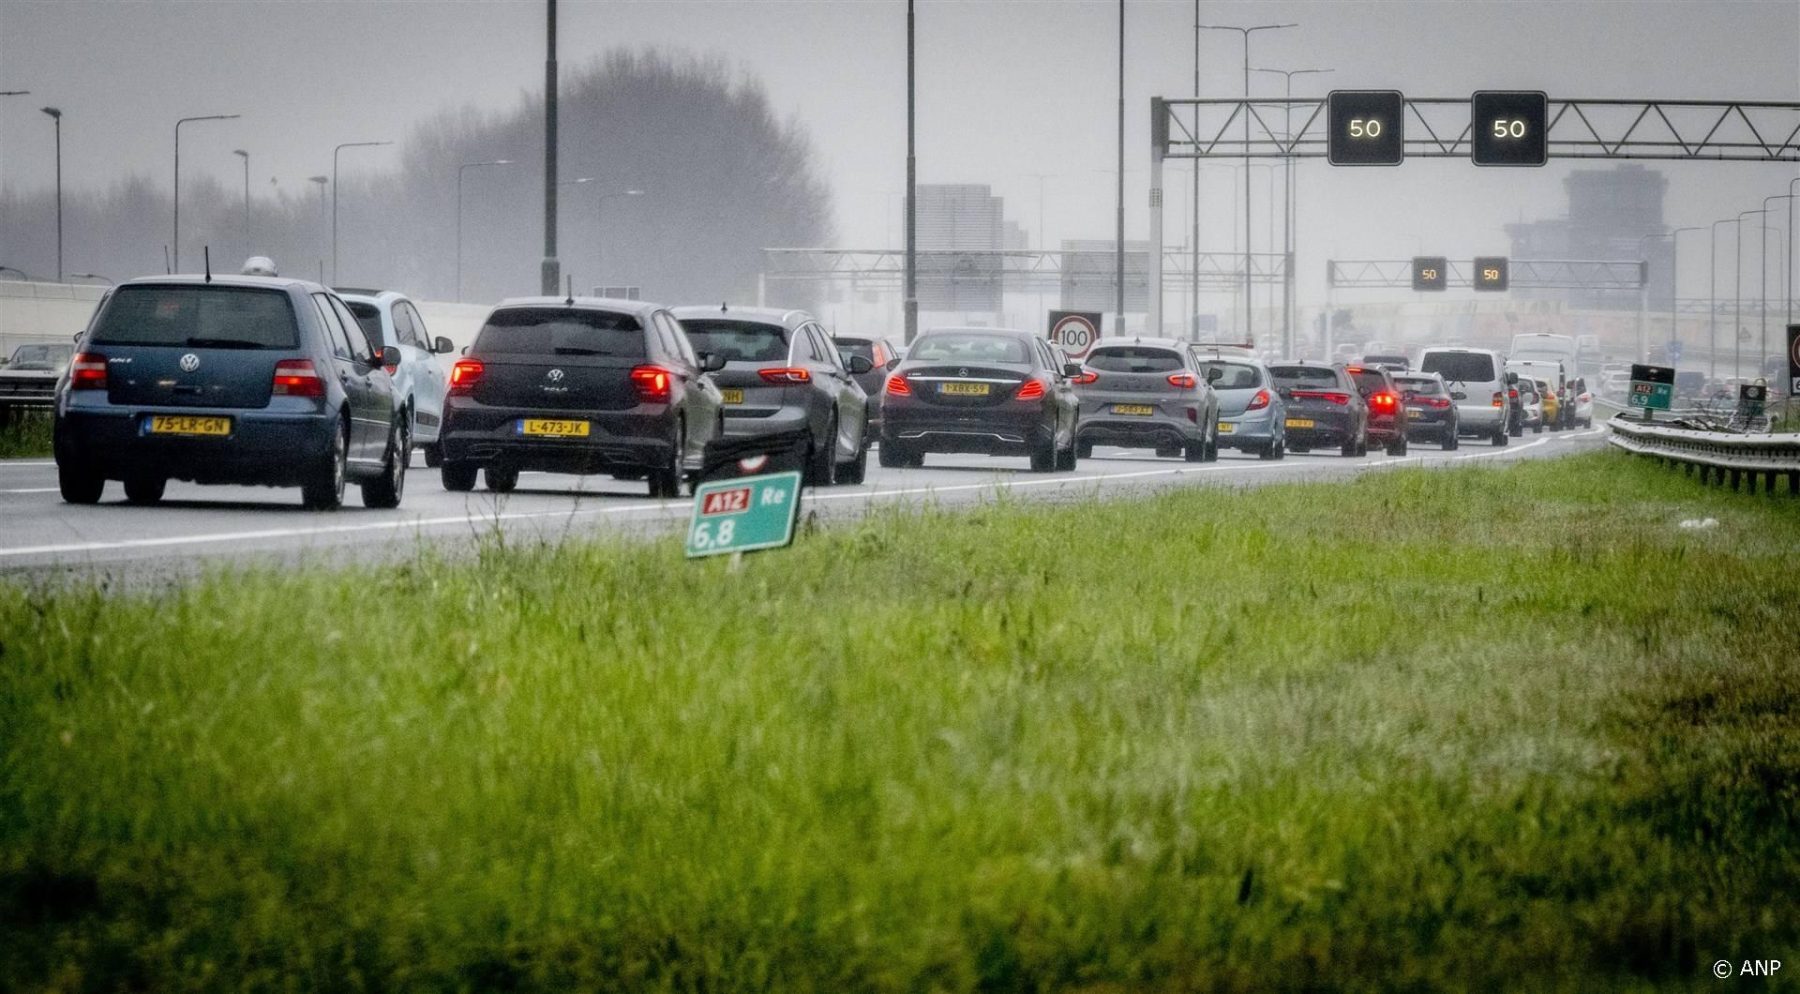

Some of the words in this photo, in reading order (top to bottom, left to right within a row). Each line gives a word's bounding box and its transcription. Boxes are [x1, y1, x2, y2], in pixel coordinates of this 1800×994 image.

[1350, 119, 1381, 137] 50
[1493, 119, 1525, 138] 50
[1422, 269, 1437, 280] 50
[1483, 269, 1499, 280] 50
[1062, 330, 1088, 346] 100
[1635, 383, 1652, 394] A12
[156, 417, 223, 432] 75-LR-GN
[529, 421, 582, 433] L-473-JK
[707, 491, 746, 512] A12
[761, 487, 785, 506] Re
[694, 519, 736, 550] 6,8
